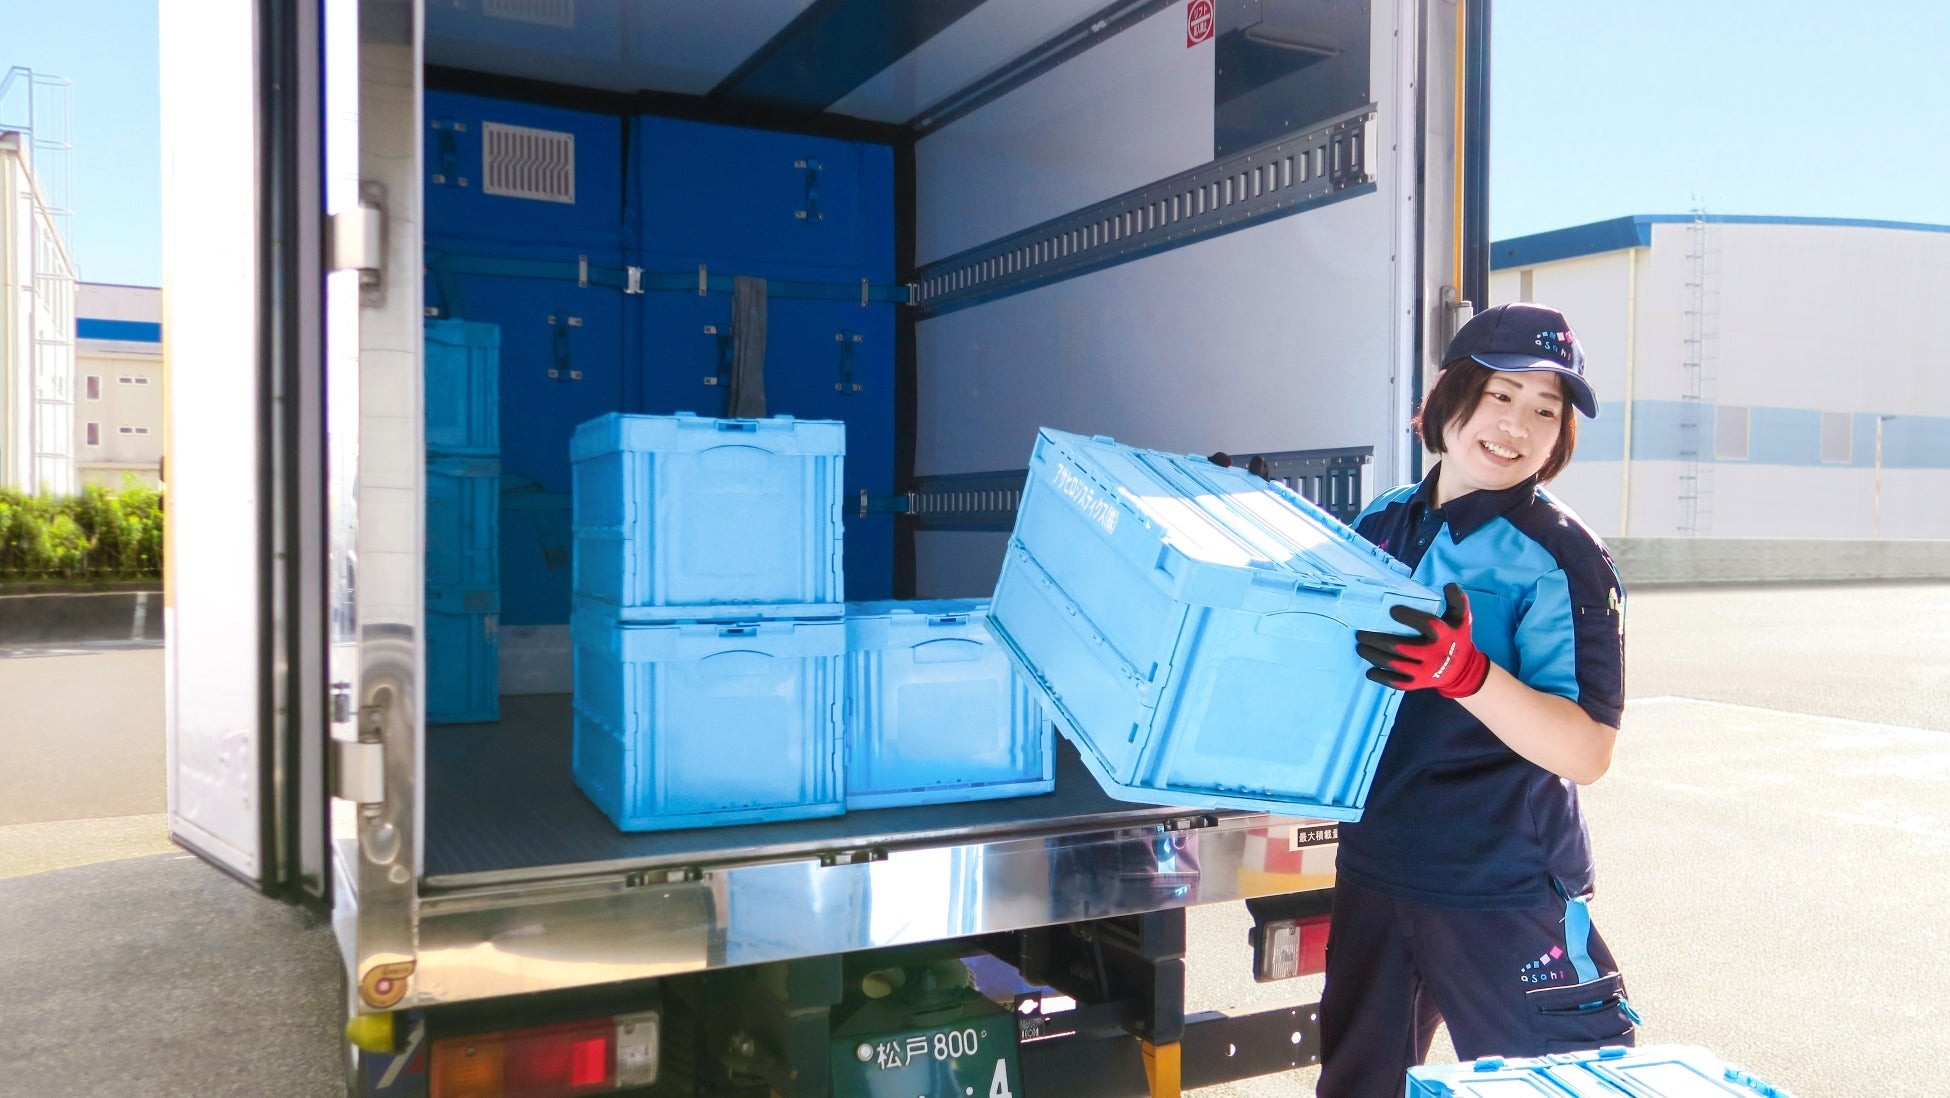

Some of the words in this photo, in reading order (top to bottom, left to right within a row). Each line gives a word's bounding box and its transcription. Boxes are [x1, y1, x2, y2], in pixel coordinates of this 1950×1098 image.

[1194, 4, 1207, 20] リフト
[1535, 339, 1571, 360] asahi
[1520, 970, 1564, 983] asahi
